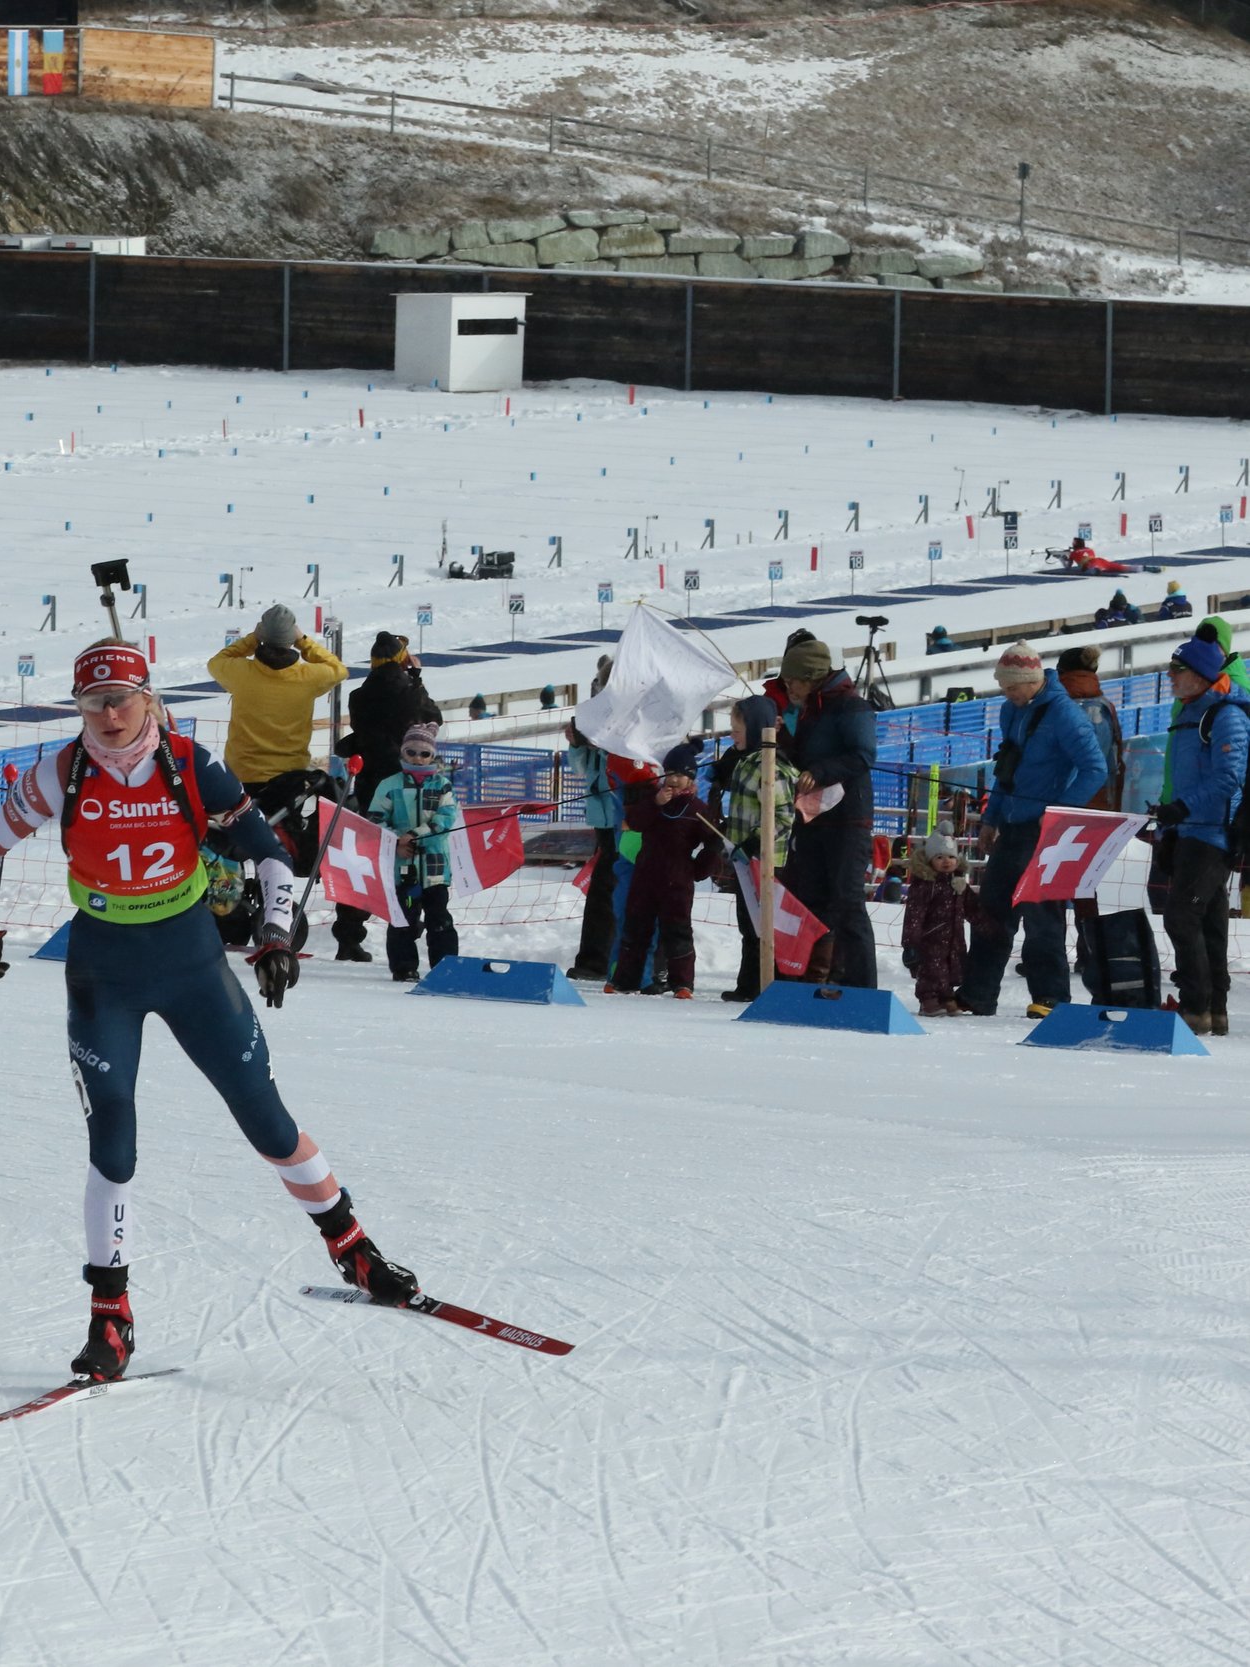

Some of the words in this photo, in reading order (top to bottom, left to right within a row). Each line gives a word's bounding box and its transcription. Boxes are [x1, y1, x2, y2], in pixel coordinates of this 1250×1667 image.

[1150, 519, 1161, 531] 14
[1004, 537, 1017, 549] 16
[930, 547, 942, 559] 17
[850, 556, 863, 568] 18
[769, 567, 782, 579] 19
[685, 577, 698, 590] 20
[599, 590, 612, 602] 21
[510, 600, 524, 614] 22
[417, 611, 432, 625] 23
[82, 655, 135, 667] ARIENS
[19, 661, 34, 676] 27
[108, 796, 180, 819] Sunris
[106, 841, 175, 882] 12
[111, 903, 127, 911] THE
[128, 899, 166, 911] OFFICIAL
[109, 1204, 125, 1266] USA
[497, 1326, 547, 1348] MADSHUS
